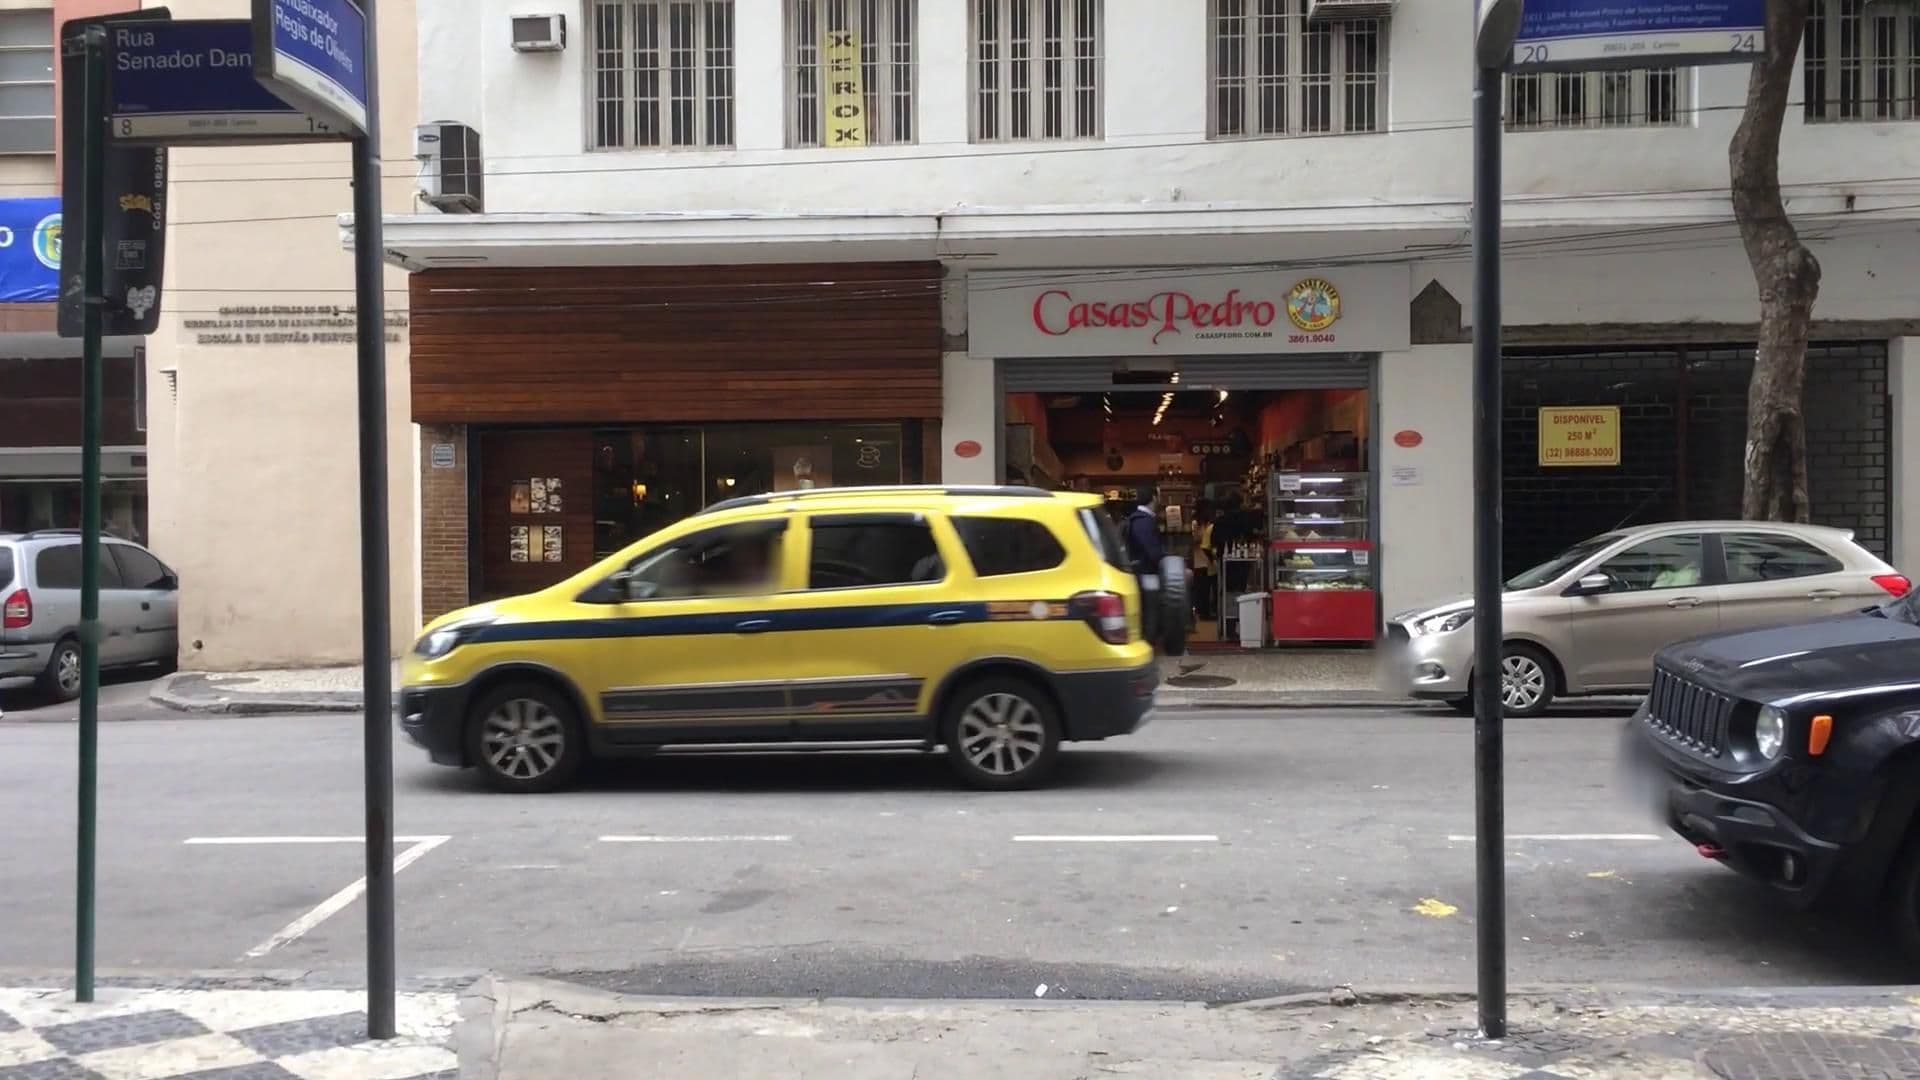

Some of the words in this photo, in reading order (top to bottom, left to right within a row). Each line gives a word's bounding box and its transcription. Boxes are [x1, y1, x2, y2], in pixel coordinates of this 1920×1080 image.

[275, 5, 308, 40] Regis
[310, 27, 324, 50] de
[116, 29, 154, 47] Rua
[1523, 44, 1548, 63] 20
[1730, 33, 1755, 52] 24
[117, 51, 203, 71] Senador
[209, 48, 252, 67] Dan
[121, 118, 133, 136] 8
[1033, 289, 1149, 335] Casas
[1149, 289, 1275, 344] Pedro
[1195, 331, 1273, 340] CASASPEDRO.COM.BR
[1288, 333, 1336, 344] 3861.9040
[1567, 431, 1583, 441] 250
[1545, 448, 1562, 459] (32)
